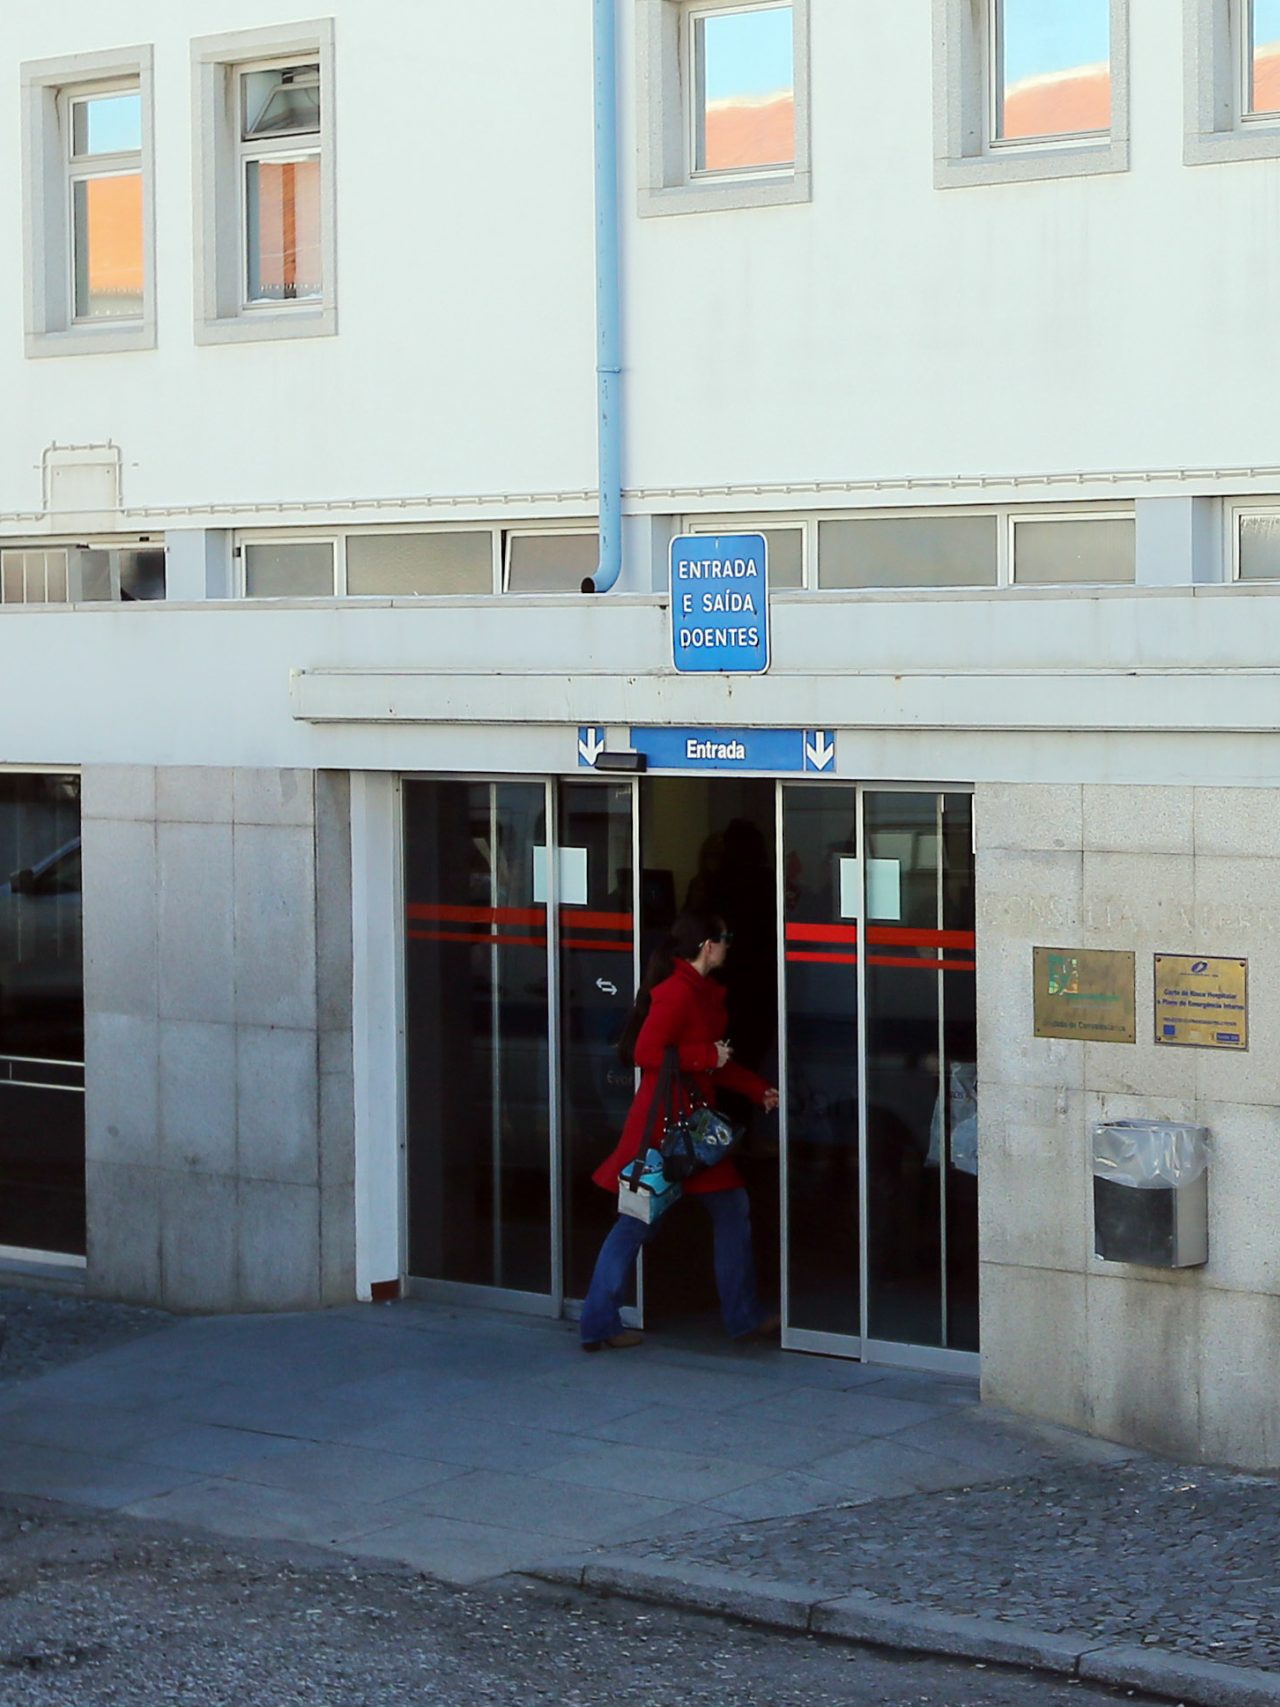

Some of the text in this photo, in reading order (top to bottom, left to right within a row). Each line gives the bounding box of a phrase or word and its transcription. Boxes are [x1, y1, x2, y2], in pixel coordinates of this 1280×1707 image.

[679, 559, 757, 578] ENTRADA
[683, 588, 754, 612] E SAÍDA
[680, 627, 759, 647] DOENTES
[686, 739, 745, 759] Entrada
